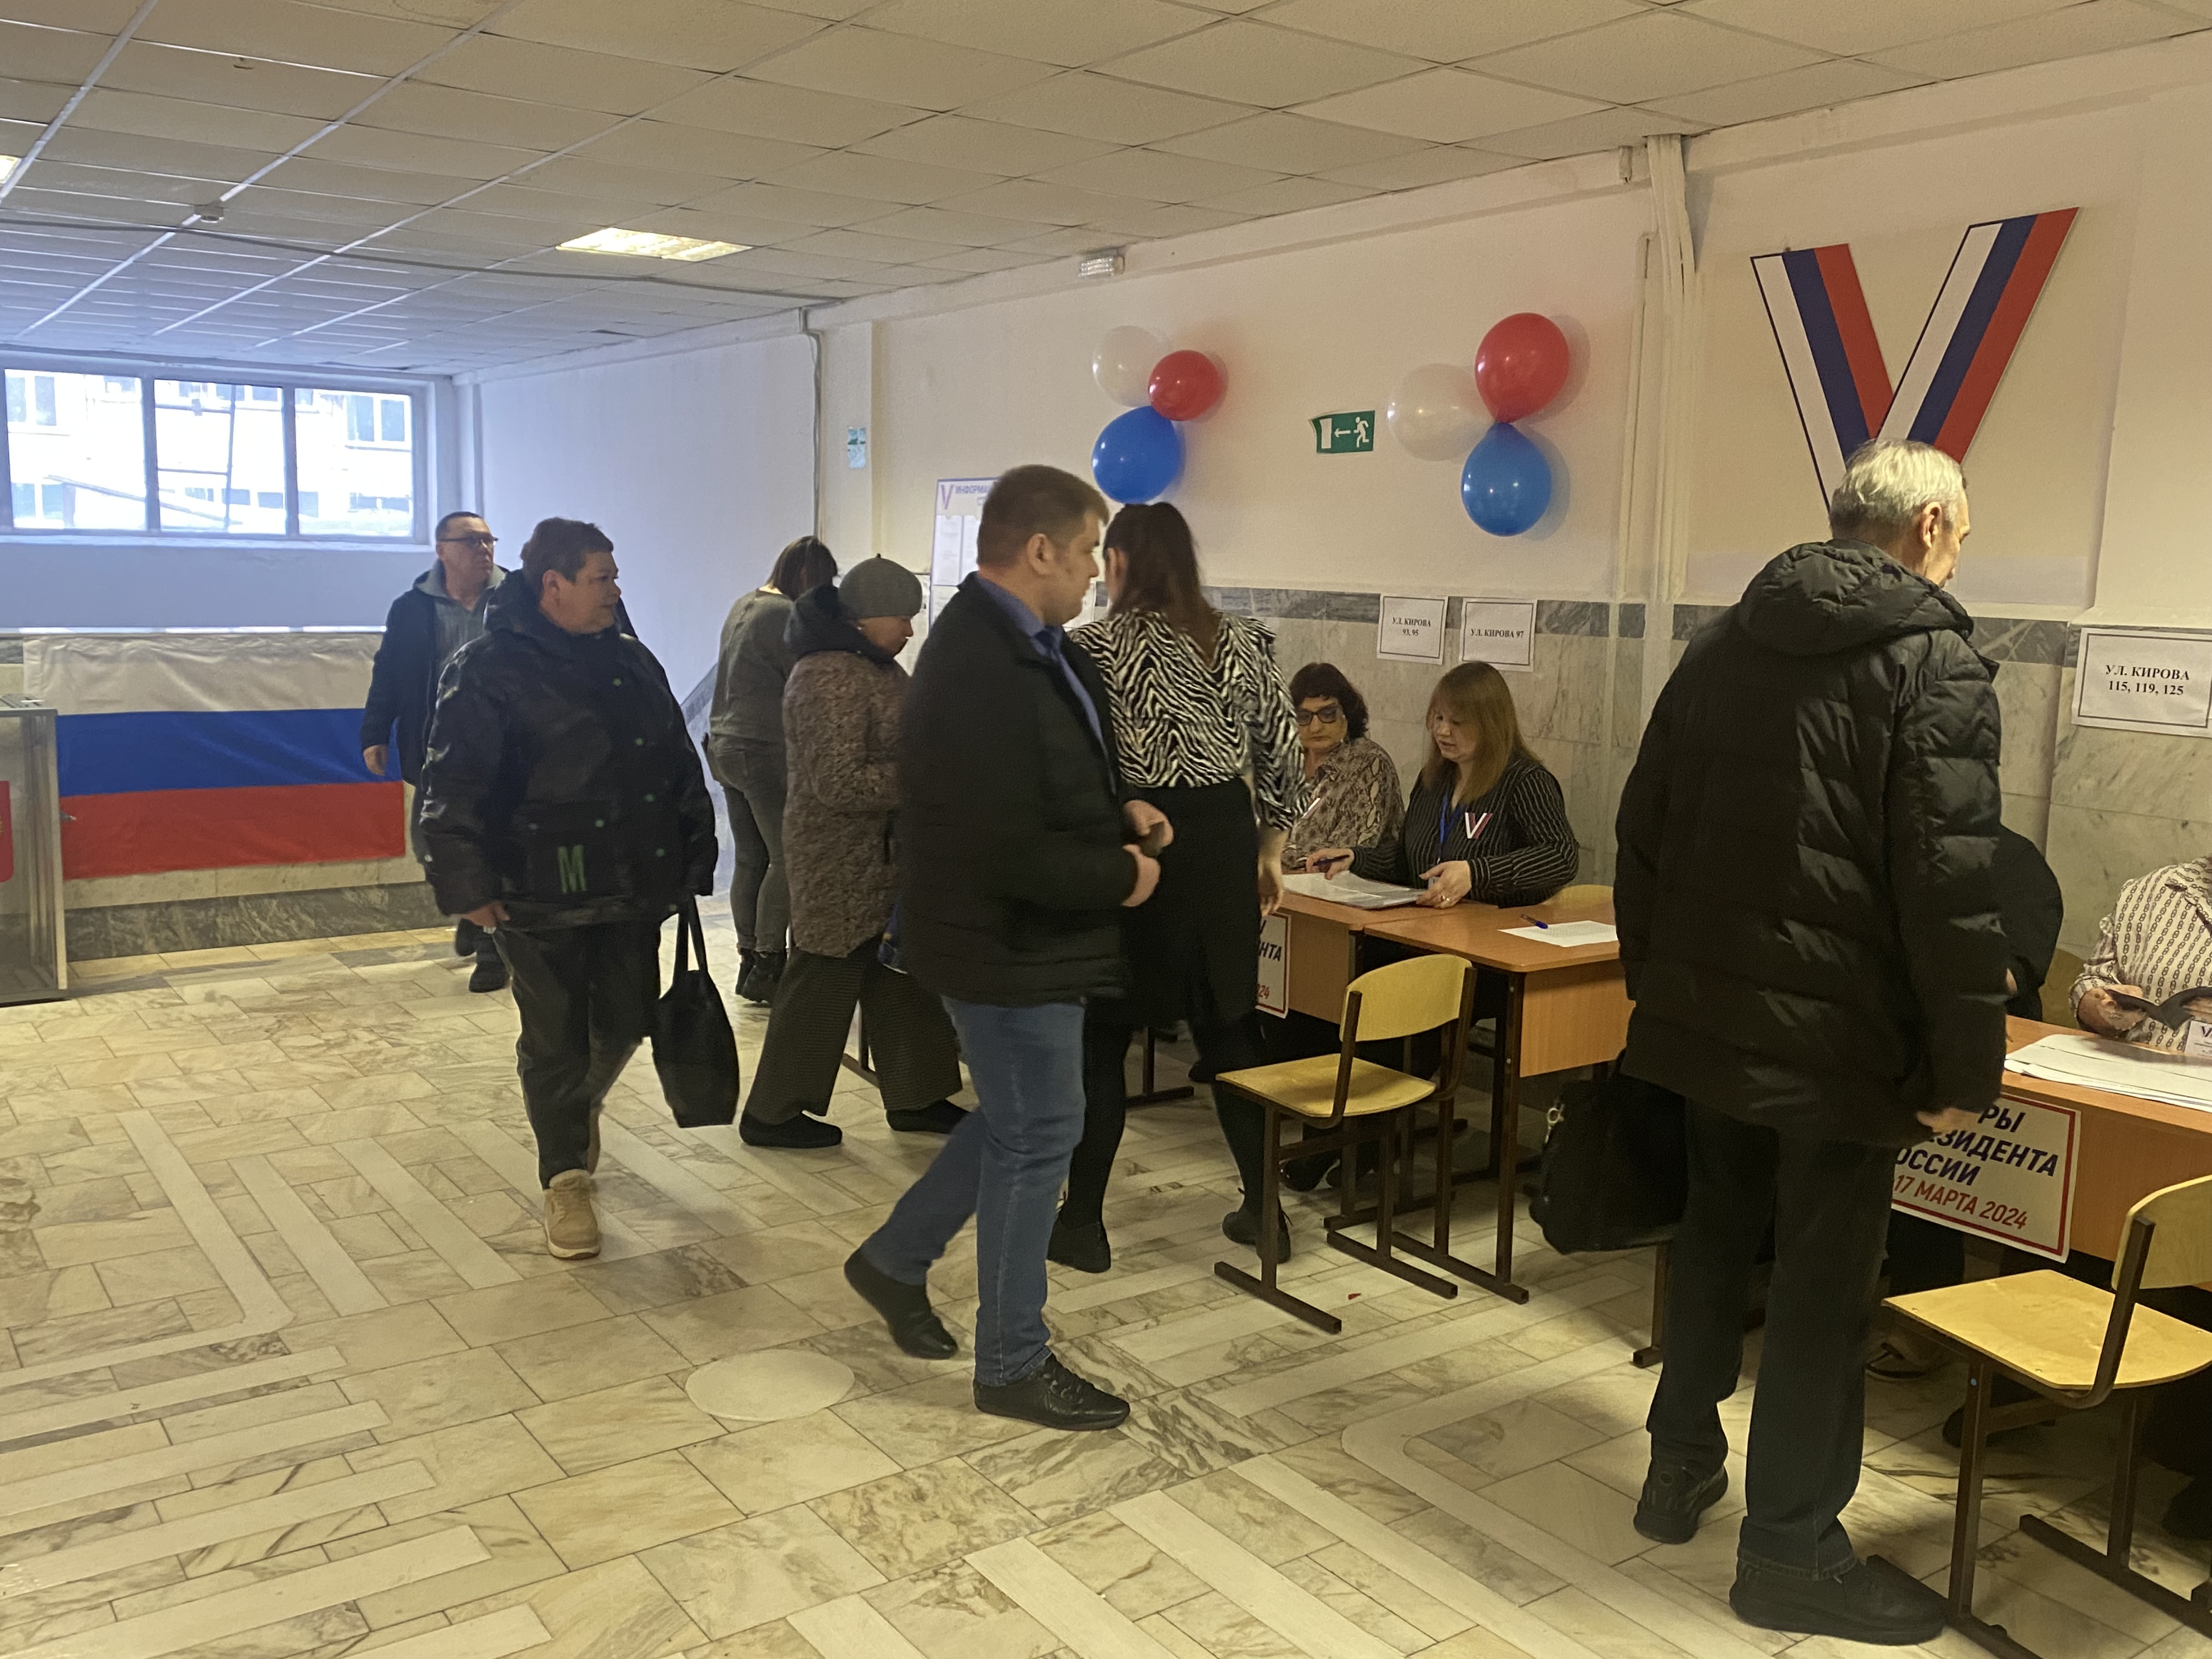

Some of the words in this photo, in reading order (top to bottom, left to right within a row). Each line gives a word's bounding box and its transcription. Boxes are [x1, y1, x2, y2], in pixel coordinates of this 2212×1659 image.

[1392, 617, 1403, 625] УЛ.
[1404, 618, 1431, 627] КИРОВА
[1470, 628, 1483, 636] УЛ.
[1484, 629, 1514, 638] КИРОВА
[2106, 664, 2127, 676] УЛ.
[2131, 666, 2189, 680] КИРОВА
[2109, 680, 2130, 693] 115,
[2136, 682, 2159, 696] 119,
[2164, 684, 2184, 696] 125
[1259, 941, 1282, 962] НТА
[1257, 984, 1270, 1000] 24
[1977, 1104, 2026, 1133] РЫ
[1929, 1128, 2059, 1177] ЗИДЕНТА
[1894, 1147, 1982, 1186] ОССИИ
[1914, 1180, 1978, 1215] МАРТА
[1979, 1200, 2028, 1230] 2024
